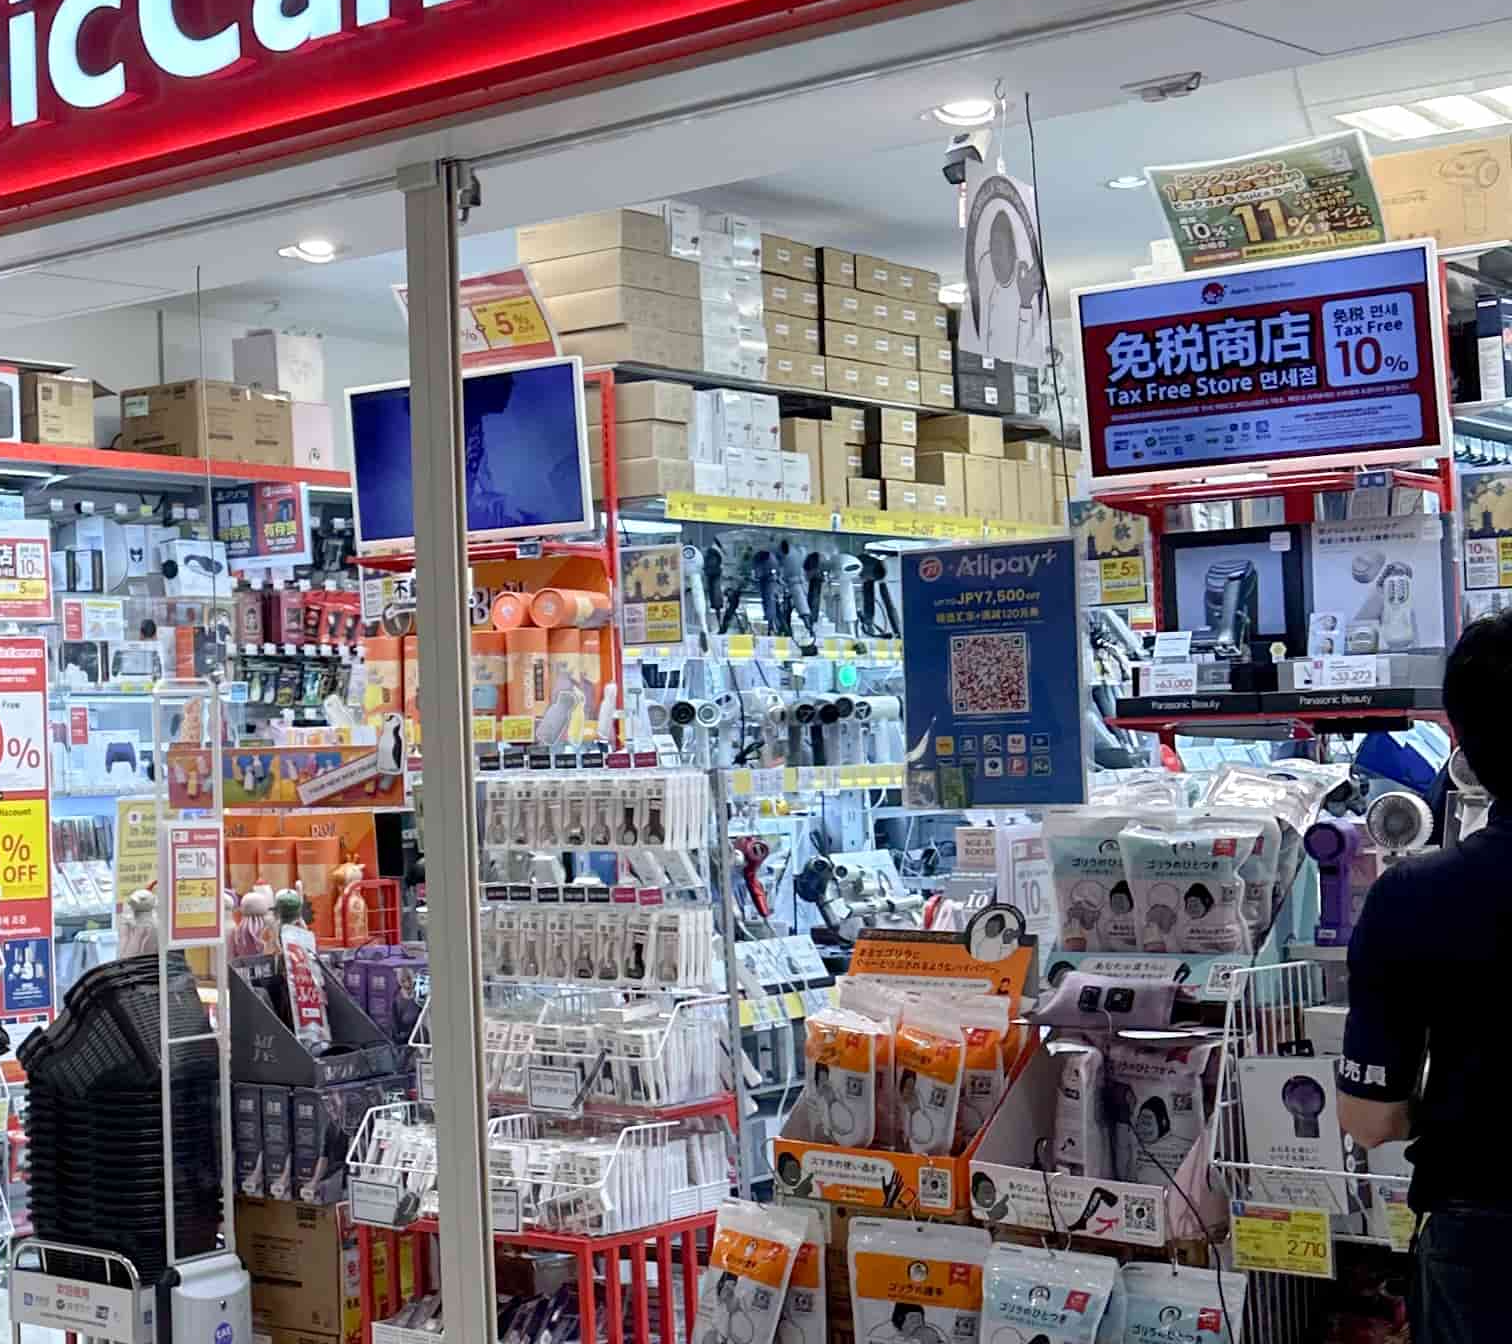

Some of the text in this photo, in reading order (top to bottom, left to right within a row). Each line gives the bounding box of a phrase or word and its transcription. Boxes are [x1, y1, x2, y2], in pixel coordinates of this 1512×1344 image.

[1332, 302, 1399, 324] 免税 면세
[1333, 319, 1404, 338] Tax Free
[1104, 310, 1312, 383] 免税商店
[1334, 336, 1410, 378] 10%
[1103, 385, 1142, 407] Tax
[1145, 381, 1192, 403] Free
[1196, 375, 1254, 398] Store
[1260, 365, 1319, 391] 면세점
[1151, 698, 1223, 712] Panasonic Beauty
[1299, 694, 1373, 707] Panasonic Beauty
[3, 864, 39, 884] OFF
